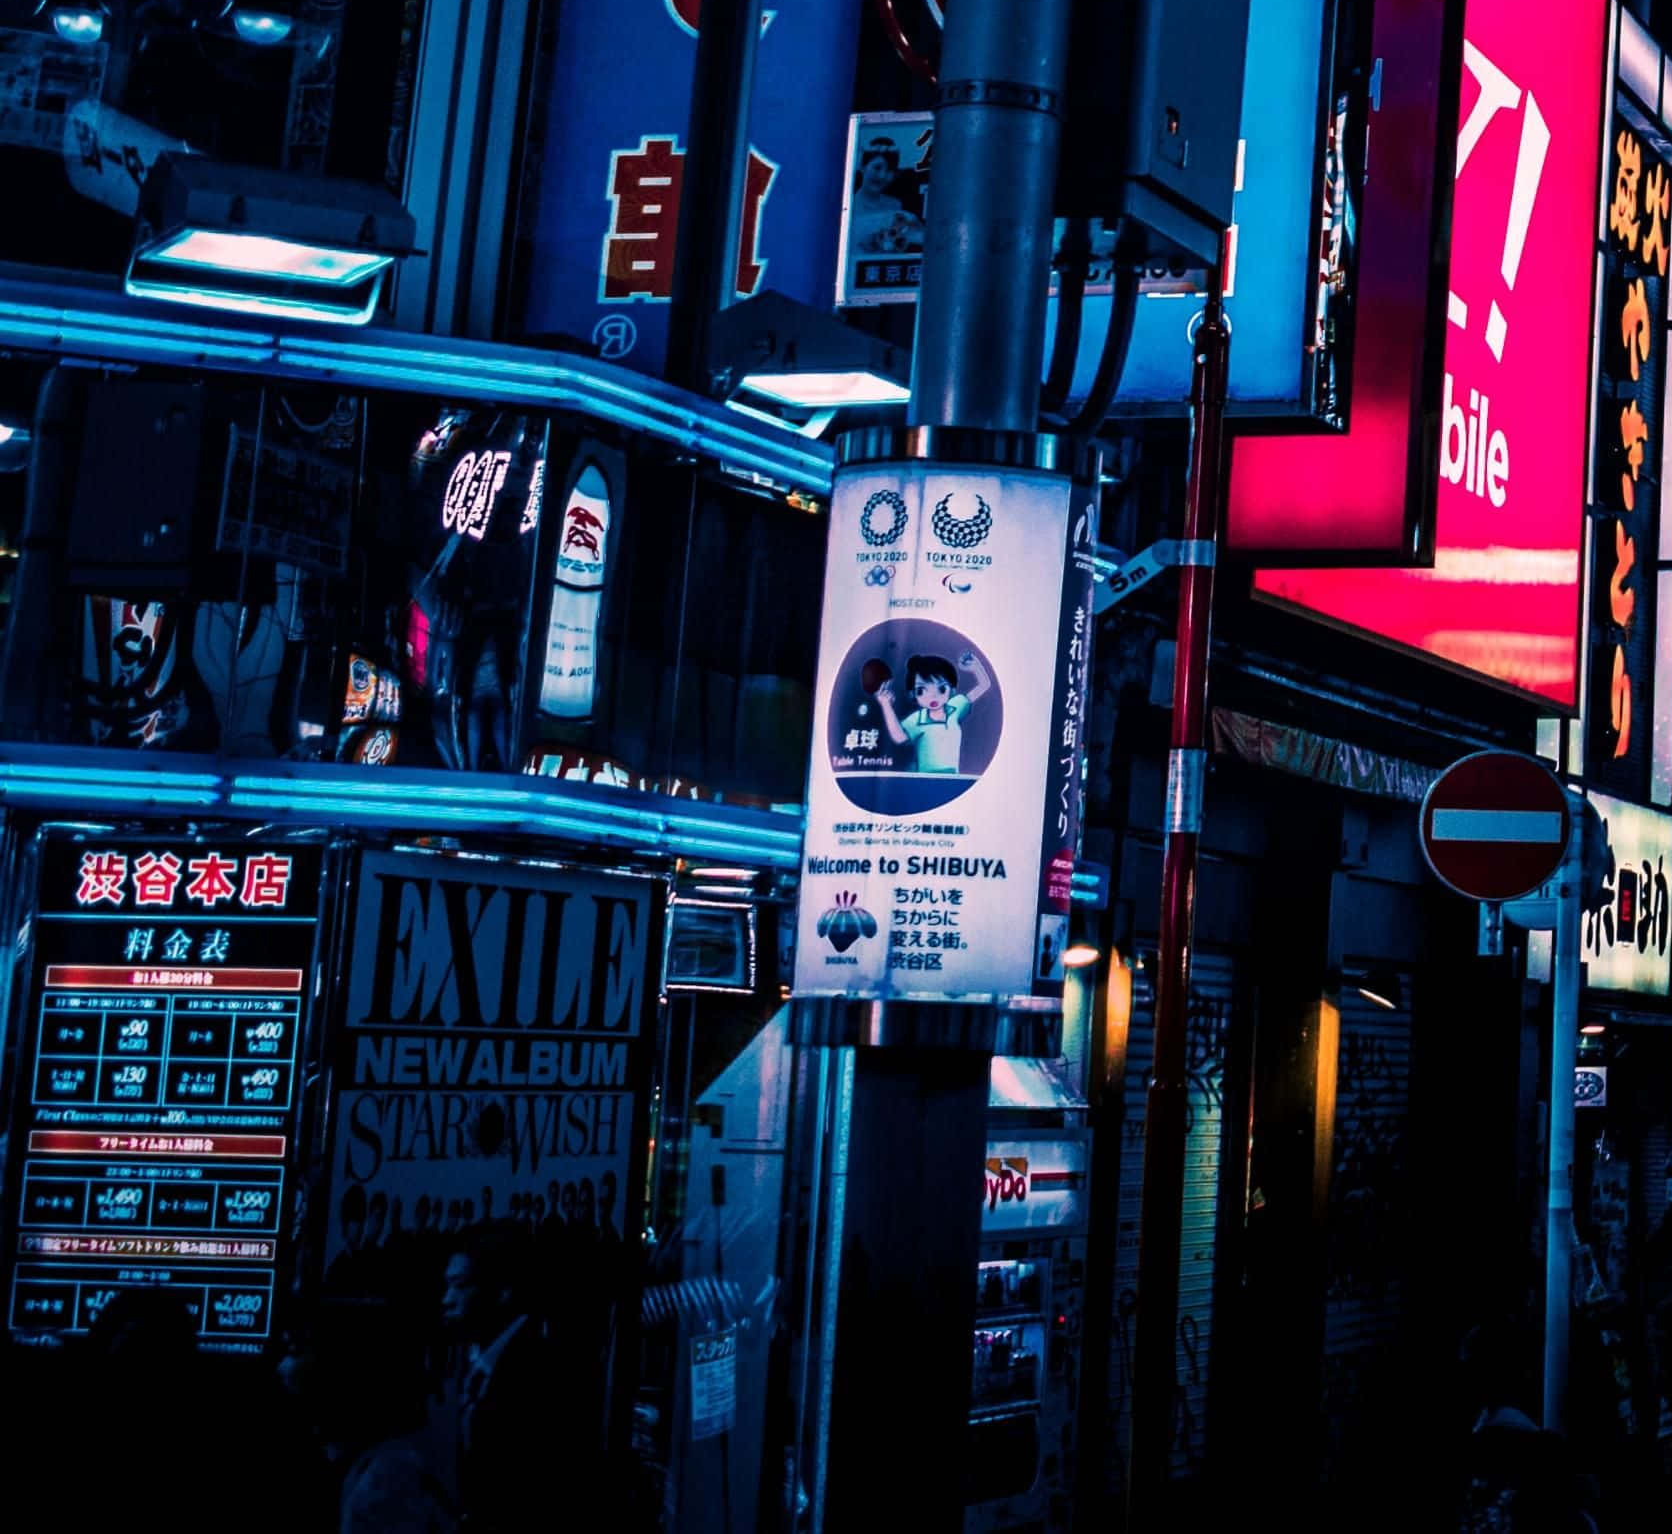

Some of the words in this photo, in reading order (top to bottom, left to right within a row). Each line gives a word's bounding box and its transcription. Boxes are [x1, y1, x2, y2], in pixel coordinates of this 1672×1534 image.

[1440, 373, 1510, 508] bile
[856, 552, 882, 562] TOKYO
[884, 552, 908, 562] 2020
[926, 552, 963, 564] TOKYO
[965, 554, 993, 565] 2020
[1108, 563, 1148, 596] 5m
[1057, 606, 1087, 838] きれいな街づくり
[844, 728, 879, 750] 卓球
[857, 755, 893, 766] Tennis
[76, 851, 292, 906] 渋谷本店
[808, 856, 871, 876] Welcome
[879, 856, 899, 875] to
[907, 855, 1007, 879] SHIBUYA
[894, 887, 964, 904] ちがいを
[892, 909, 959, 927] ちからに
[124, 928, 230, 961] 料金表
[361, 873, 639, 1035] EXILE
[891, 930, 968, 950] 変える街。
[354, 1039, 467, 1086] NEW
[467, 1041, 628, 1086] ALBUM
[344, 1091, 472, 1181] STAR
[498, 1093, 621, 1179] WISH
